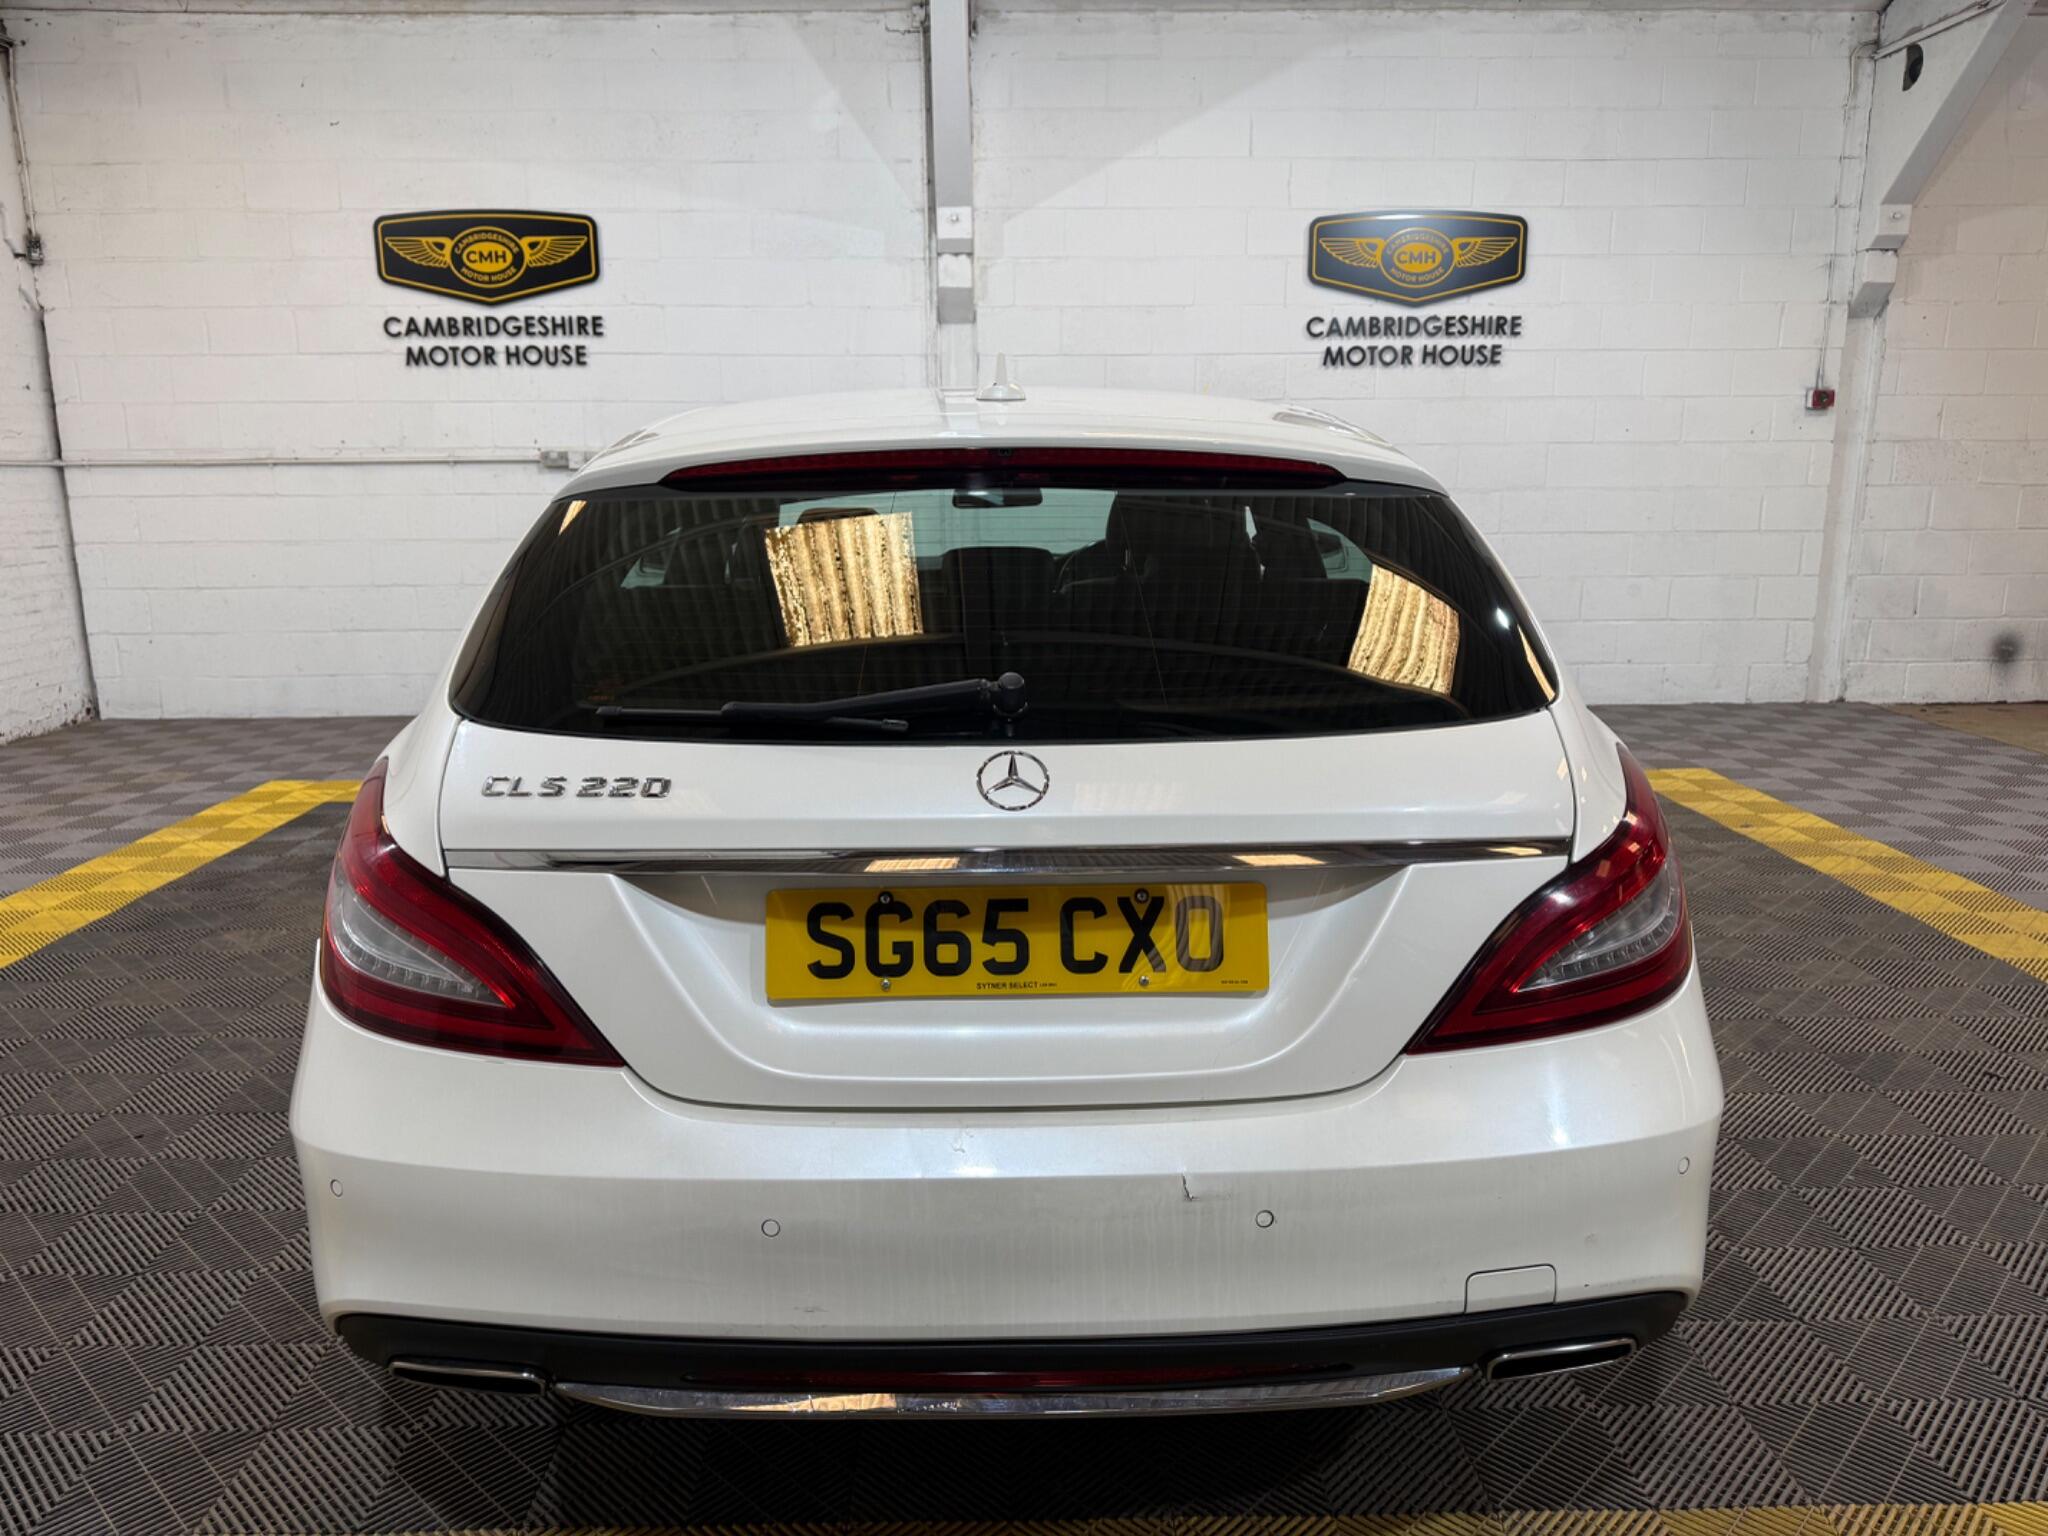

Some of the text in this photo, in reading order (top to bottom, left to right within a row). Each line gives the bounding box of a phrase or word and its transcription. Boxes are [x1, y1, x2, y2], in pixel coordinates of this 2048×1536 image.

[466, 250, 507, 264] CMH
[1396, 250, 1437, 265] CMH
[460, 265, 518, 282] MOTOR HOUSE
[383, 315, 604, 338] CAMBRIDGESHIRE
[1306, 315, 1522, 338] CAMBRIDGESHIRE
[406, 345, 588, 367] MOTOR HOUSE
[1323, 344, 1502, 367] MOTOR HOUSE
[481, 776, 672, 798] CLS 220
[806, 895, 1225, 979] SG65 CXO
[1009, 981, 1038, 989] SELECT
